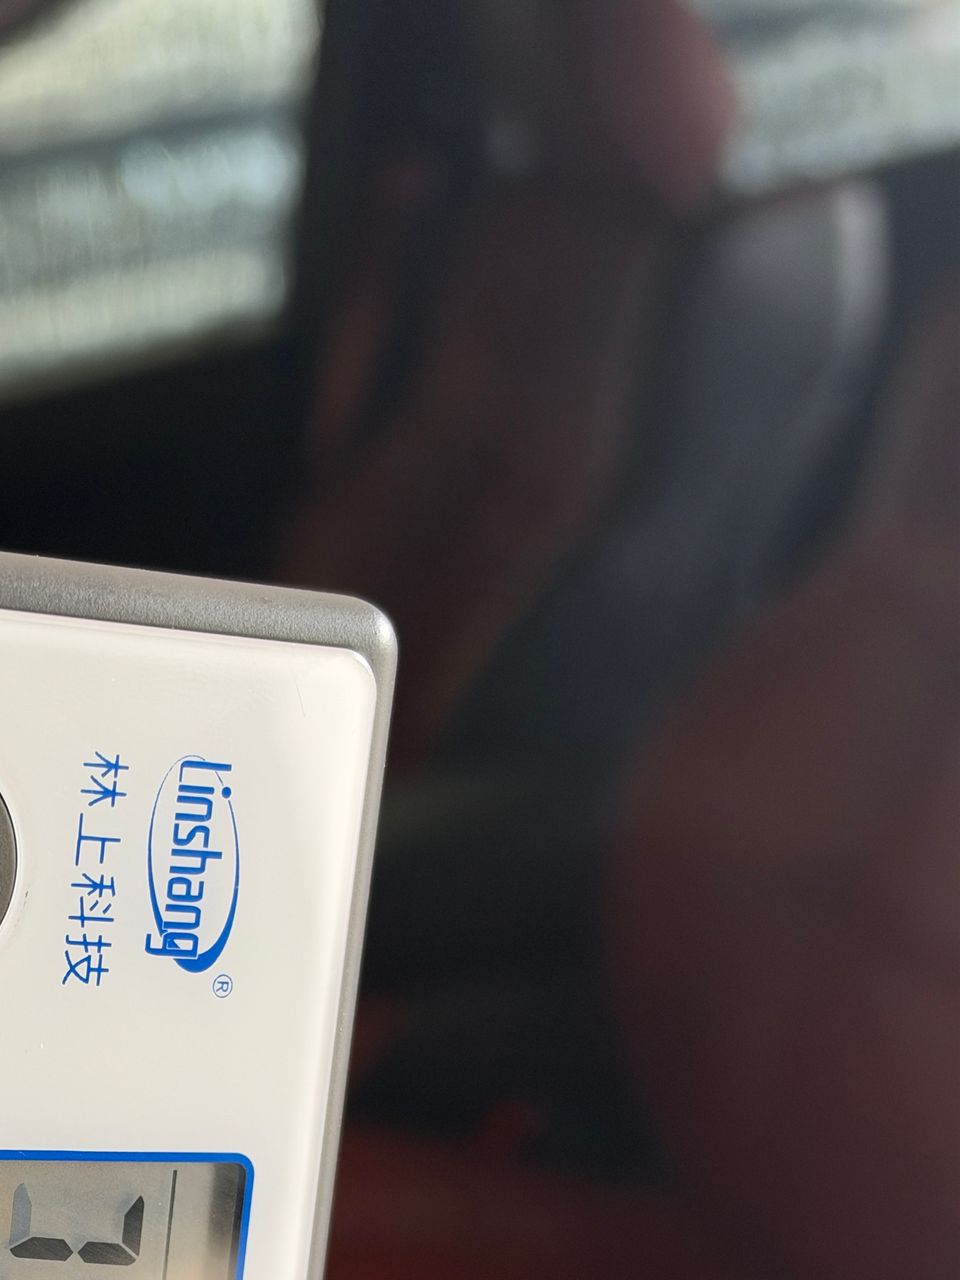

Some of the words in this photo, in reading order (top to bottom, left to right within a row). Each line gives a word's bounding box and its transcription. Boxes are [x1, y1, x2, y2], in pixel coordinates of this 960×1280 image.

[62, 752, 128, 986] 林上科技
[144, 759, 234, 962] Linshang
